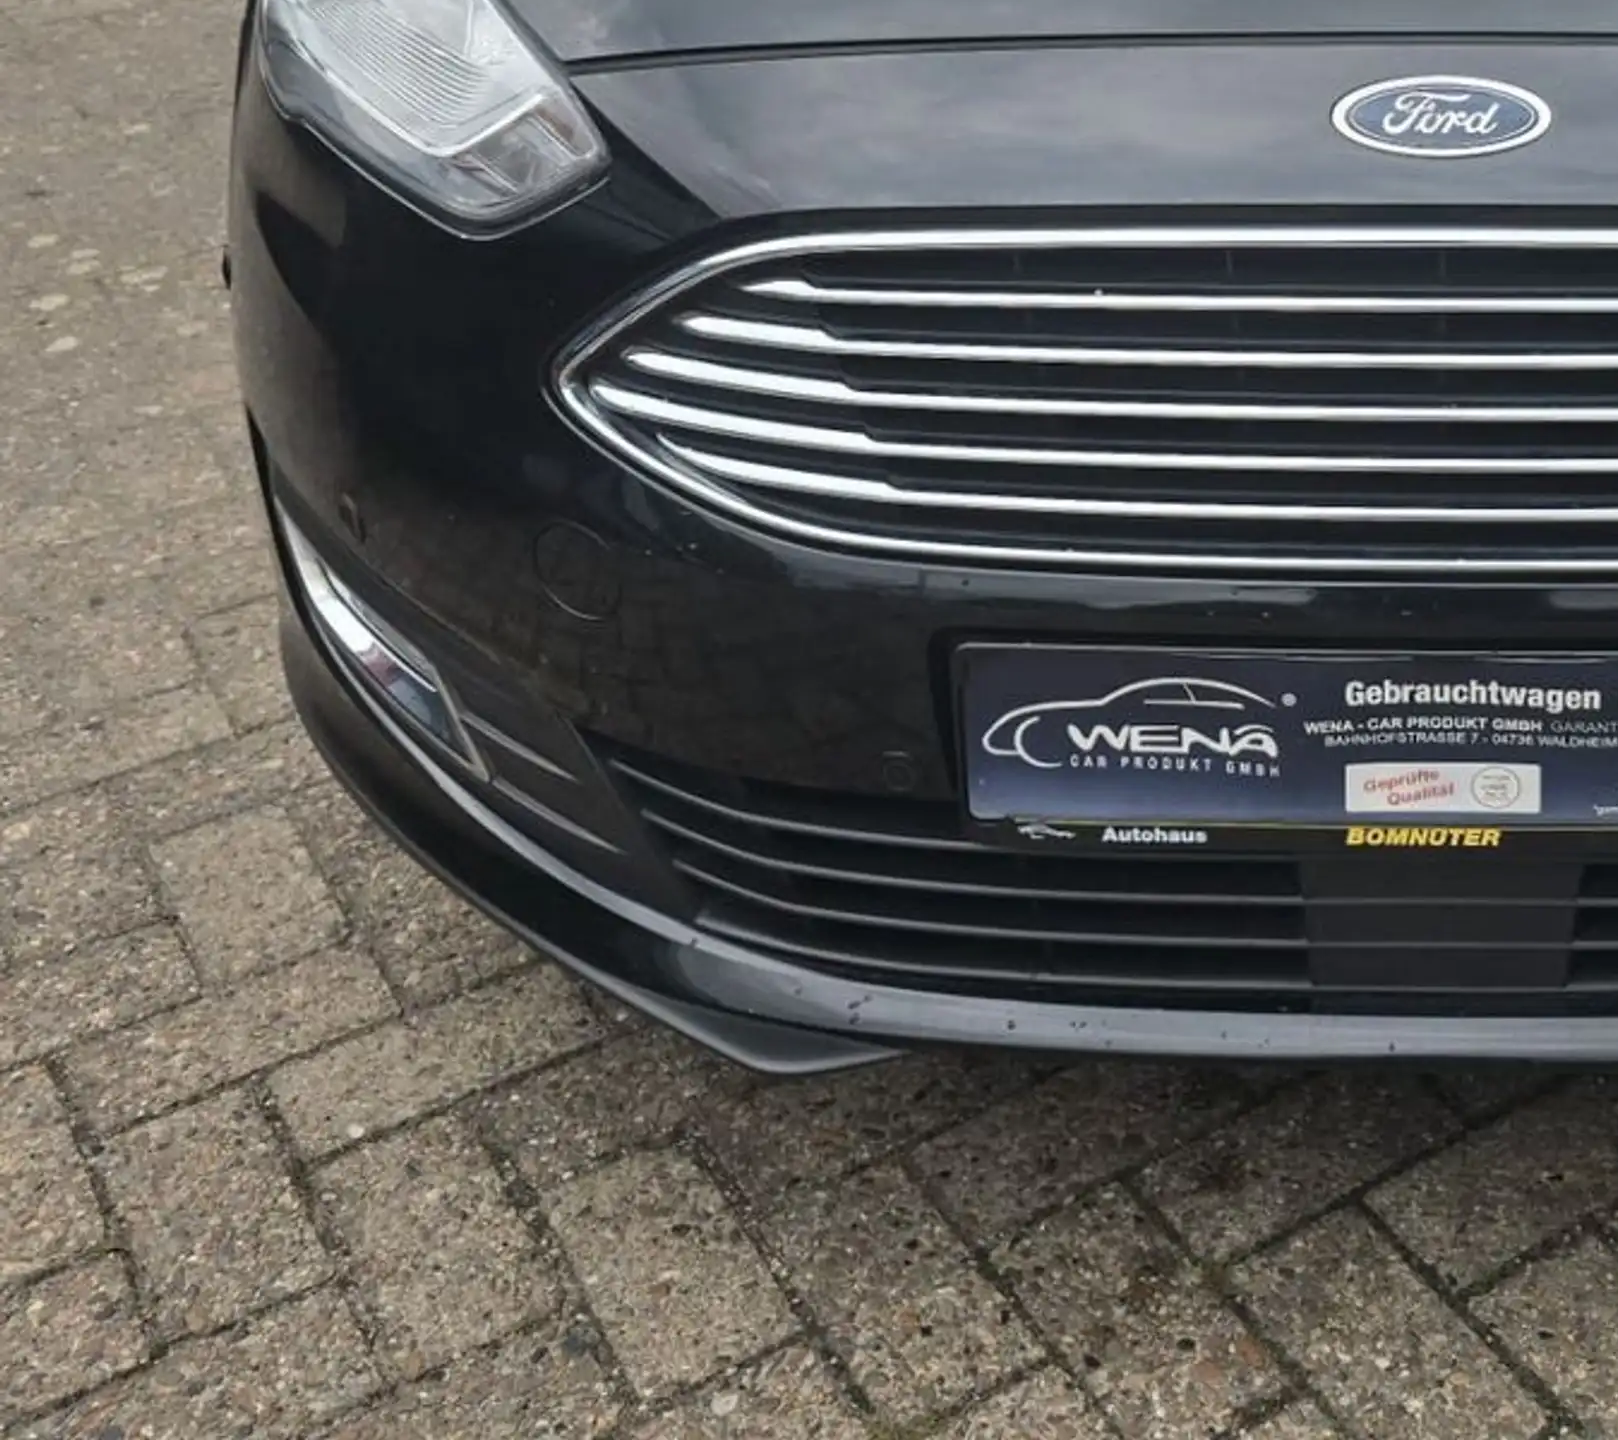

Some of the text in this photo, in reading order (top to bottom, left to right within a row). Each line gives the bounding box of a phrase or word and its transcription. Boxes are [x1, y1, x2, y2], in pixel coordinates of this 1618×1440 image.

[1382, 91, 1500, 134] Ford
[1345, 679, 1602, 714] Gebrauchtwagen
[1303, 719, 1355, 735] WENA
[1367, 717, 1402, 731] CAR
[1406, 716, 1488, 731] PRODUKT
[1492, 717, 1542, 733] GMBH
[1324, 731, 1467, 747] BAHNHOFSTRASSE
[1470, 732, 1477, 745] 7
[1537, 734, 1618, 748] WALDHEIM
[1070, 755, 1280, 778] CAR PRODUKT GMBH
[1363, 768, 1440, 794] Geprüfte
[1386, 782, 1454, 807] Qualität
[1102, 826, 1208, 844] Autohaus
